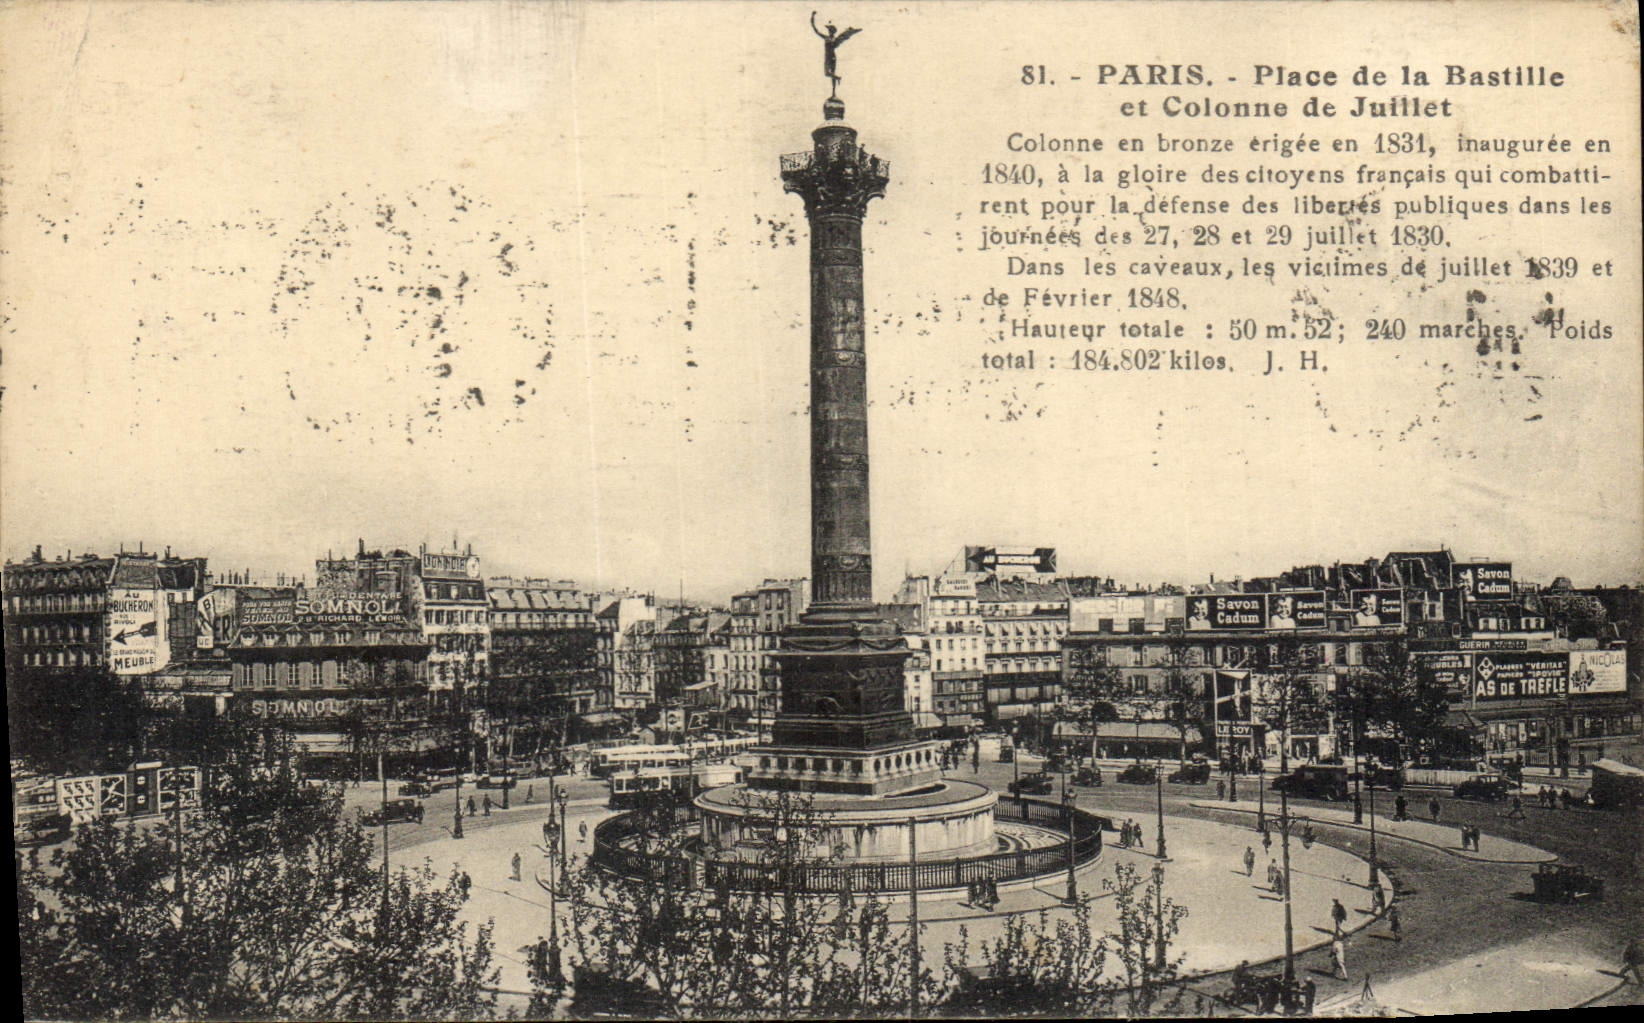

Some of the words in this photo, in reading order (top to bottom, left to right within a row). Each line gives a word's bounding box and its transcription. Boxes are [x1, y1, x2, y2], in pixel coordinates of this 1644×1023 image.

[1478, 567, 1510, 579] Savon
[1478, 581, 1510, 593] Cadum
[113, 600, 153, 612] BUCHERON
[1216, 597, 1260, 610] Savon
[1217, 611, 1260, 625] Cadum
[1297, 612, 1325, 620] Cadum
[1589, 652, 1625, 668] NICOLAS
[1476, 680, 1496, 697] AS
[1500, 682, 1516, 696] DE
